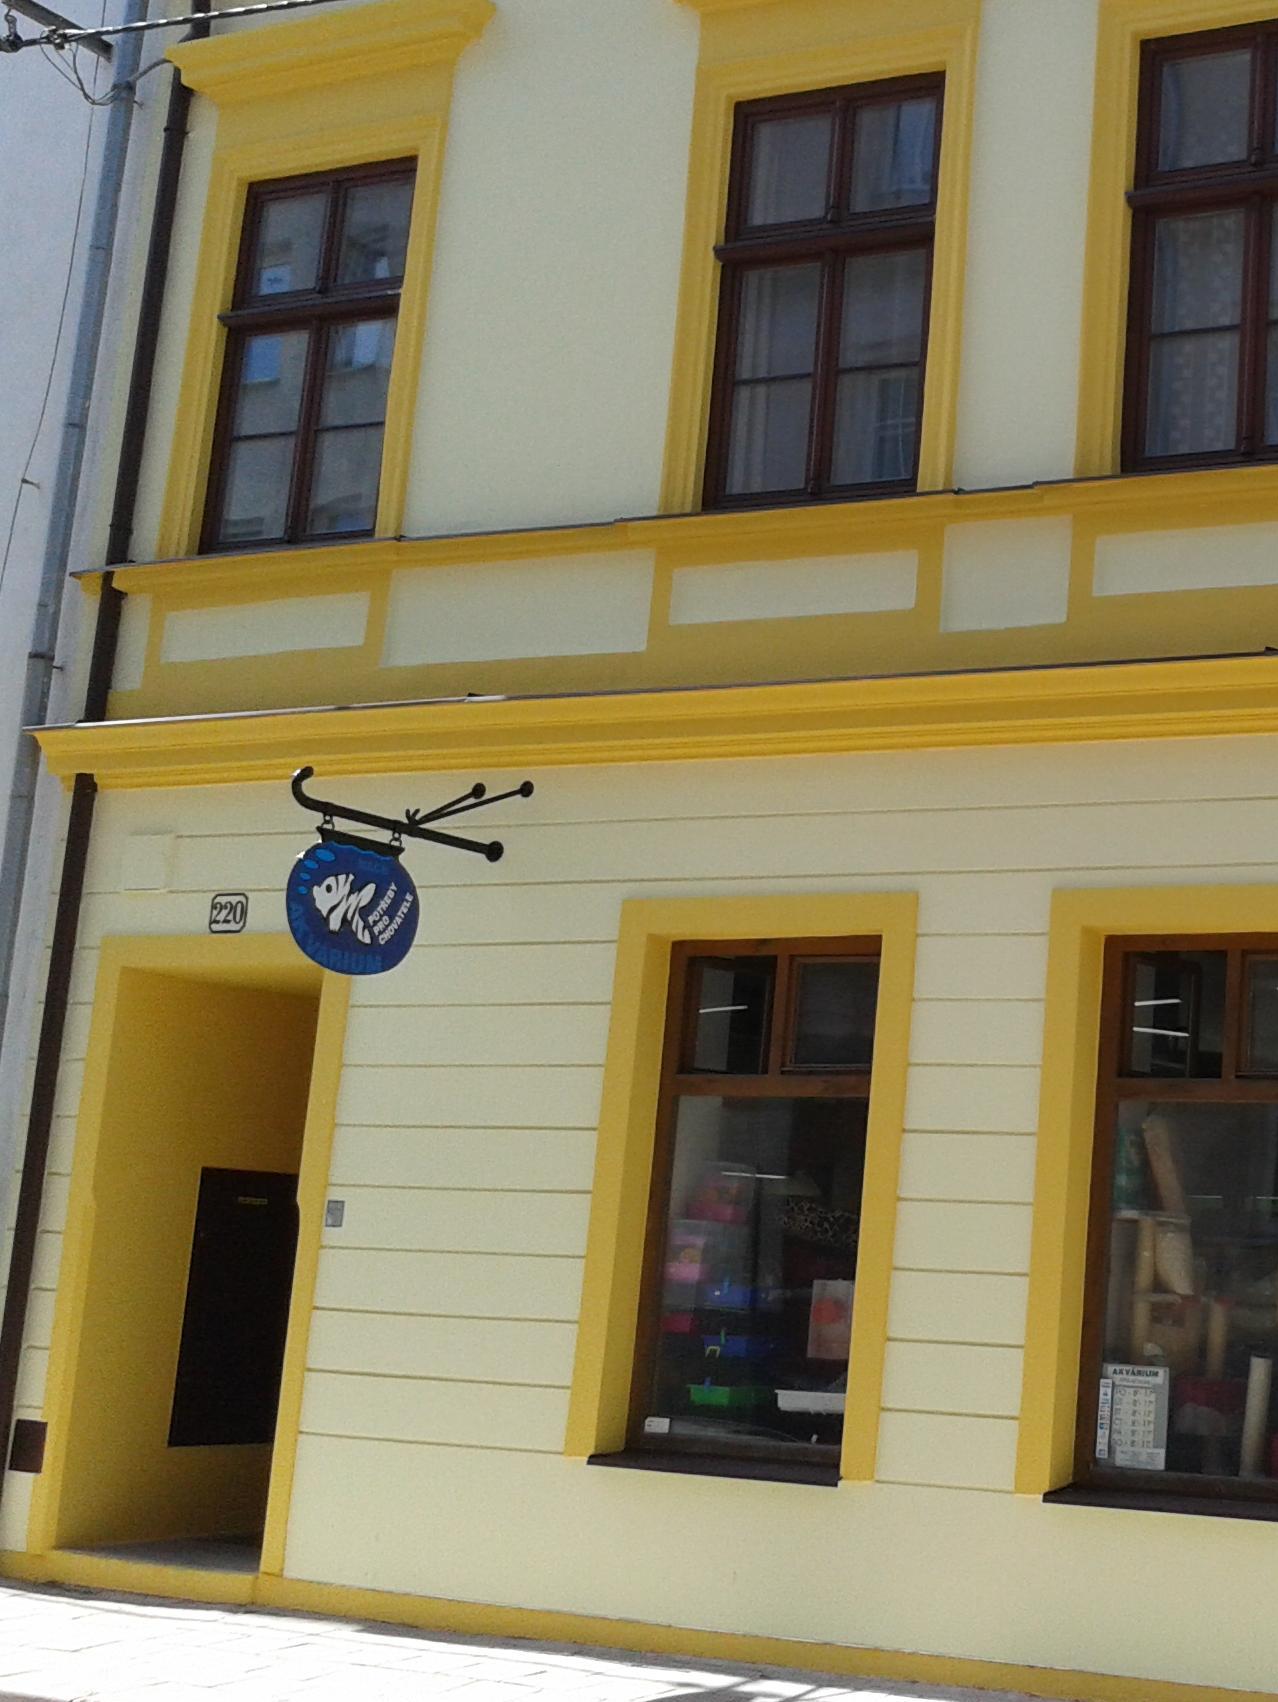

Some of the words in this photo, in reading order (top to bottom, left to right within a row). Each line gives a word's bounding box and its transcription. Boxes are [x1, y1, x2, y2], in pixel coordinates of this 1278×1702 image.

[210, 901, 244, 925] 220
[378, 892, 414, 945] CHOVATELE
[373, 915, 390, 937] PRO
